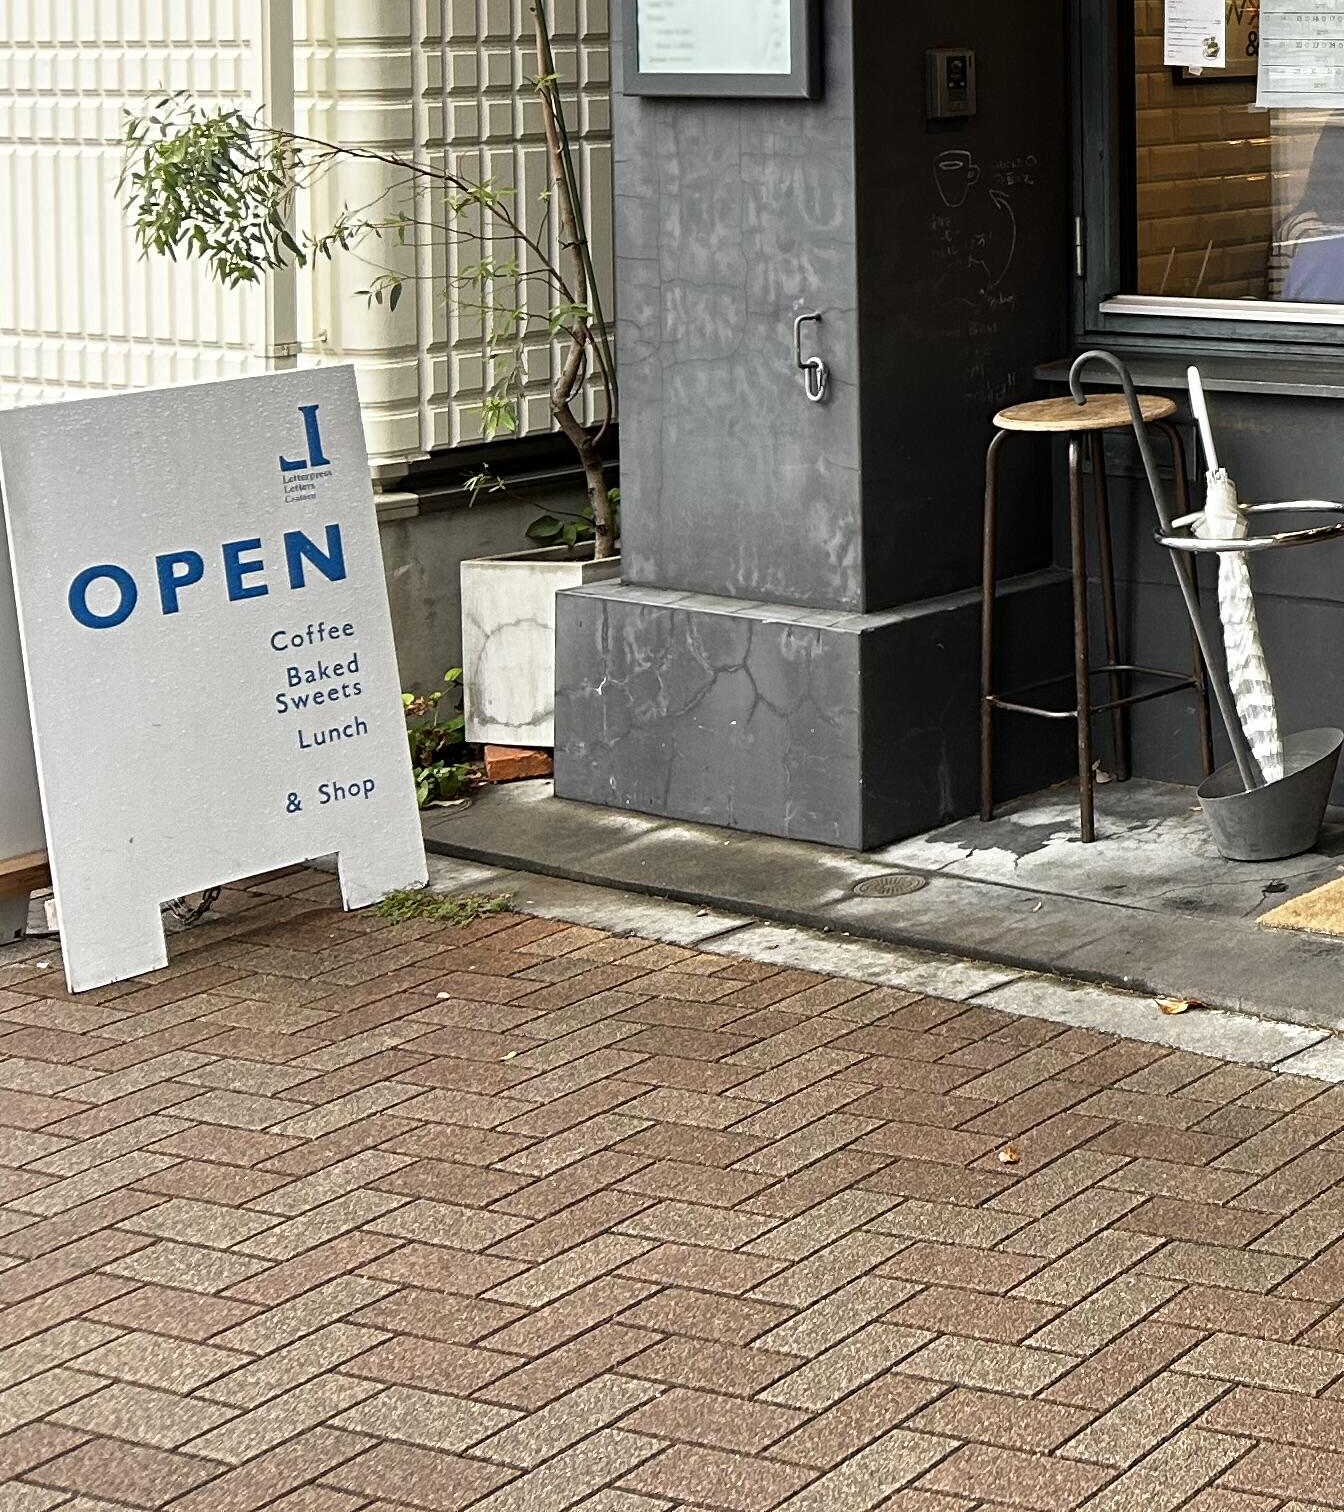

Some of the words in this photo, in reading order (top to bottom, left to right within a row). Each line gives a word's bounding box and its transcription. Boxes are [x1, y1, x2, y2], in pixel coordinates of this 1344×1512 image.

[282, 470, 333, 485] Letterpress
[284, 483, 316, 494] Letters
[67, 522, 348, 630] OPEN
[270, 618, 356, 653] Coffee
[286, 652, 361, 688] Baked
[275, 679, 364, 715] Sweets
[297, 715, 369, 750] Lunch
[285, 791, 303, 815] &
[317, 775, 377, 806] Shop
